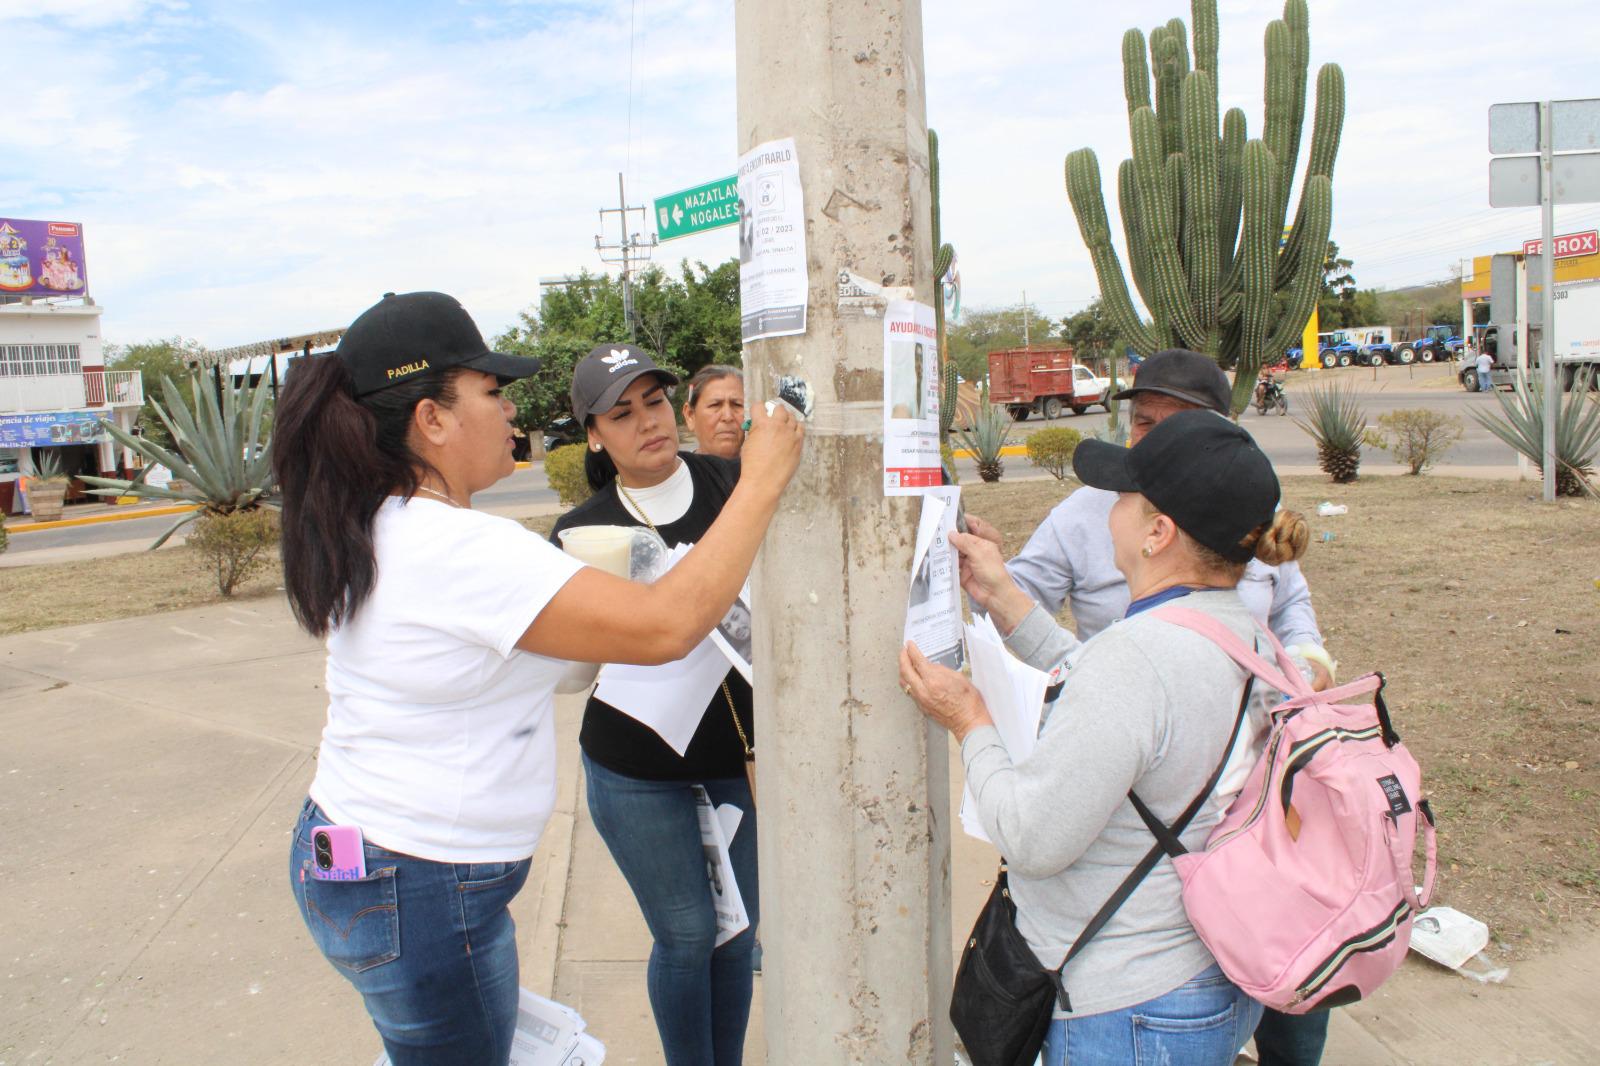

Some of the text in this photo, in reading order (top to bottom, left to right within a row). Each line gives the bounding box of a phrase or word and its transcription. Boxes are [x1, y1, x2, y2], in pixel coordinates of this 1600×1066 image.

[684, 183, 739, 210] MAZATLAN
[690, 202, 740, 226] NOGALES
[775, 224, 793, 234] 2023
[386, 359, 430, 380] PADILLA
[608, 358, 639, 373] adidas
[24, 415, 33, 423] de
[35, 414, 56, 424] viajes
